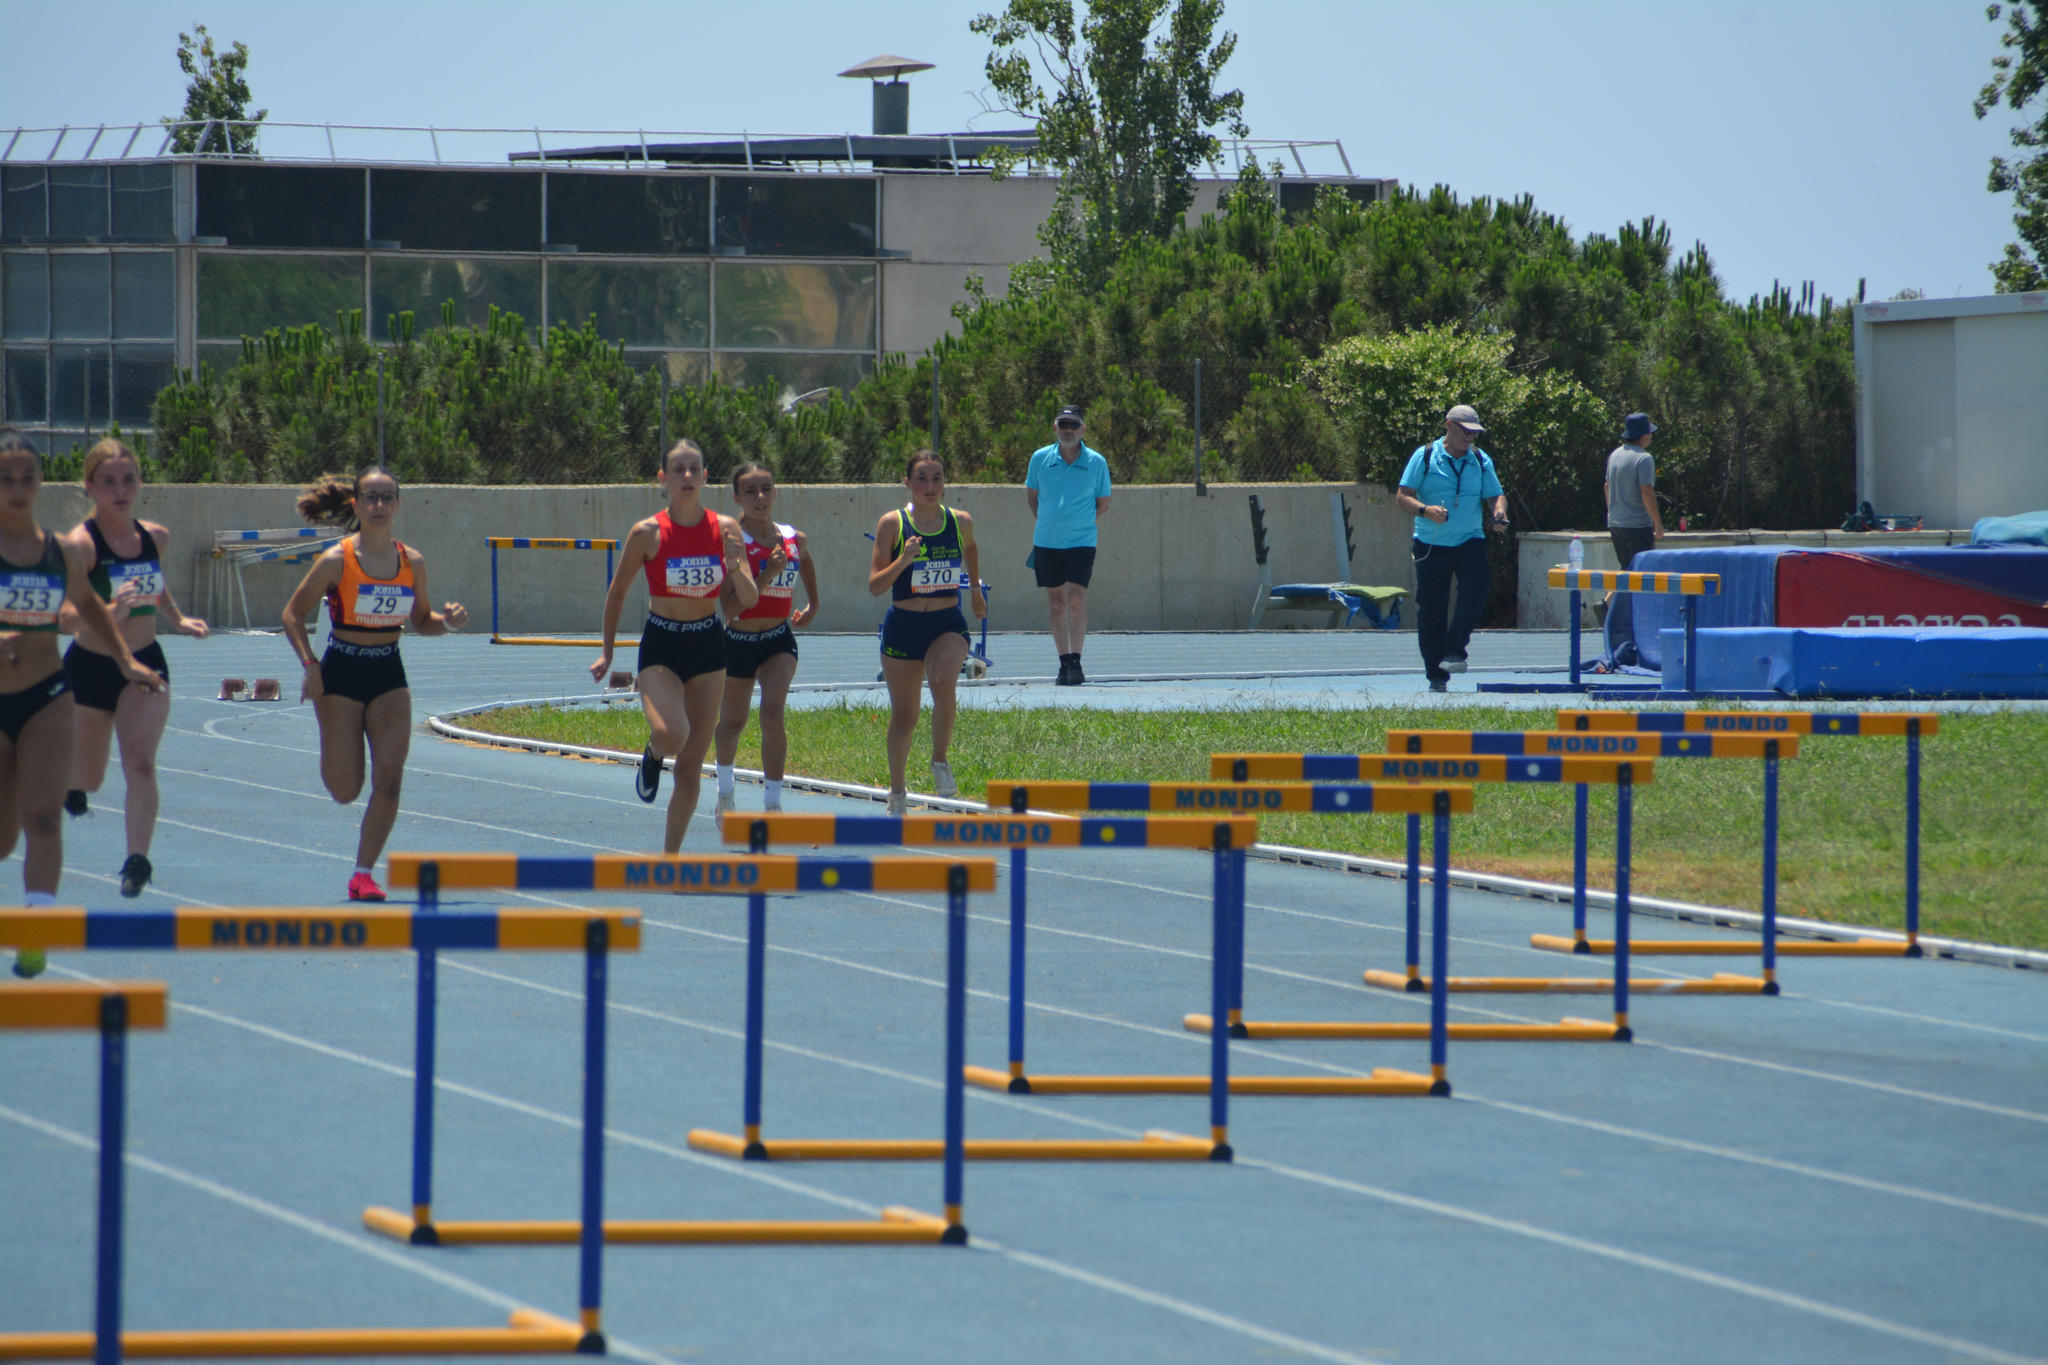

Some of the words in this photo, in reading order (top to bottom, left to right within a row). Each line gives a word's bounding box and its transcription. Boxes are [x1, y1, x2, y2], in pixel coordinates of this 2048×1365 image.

[124, 575, 156, 595] 55
[677, 567, 715, 586] 338
[768, 572, 796, 588] 18
[920, 569, 952, 584] 370
[4, 589, 51, 612] 253
[371, 597, 398, 614] 29
[648, 615, 678, 633] NIKE
[681, 617, 714, 633] PRO
[727, 629, 758, 642] NIKE
[760, 625, 786, 641] PRO
[359, 646, 392, 657] PRO
[1703, 716, 1789, 731] MONDO
[1547, 736, 1638, 753] MONDO
[1381, 760, 1480, 778] MONDO
[1175, 790, 1283, 809] MONDO
[934, 822, 1052, 843] MONDO
[624, 862, 760, 886] MONDO
[211, 918, 367, 947] MONDO
